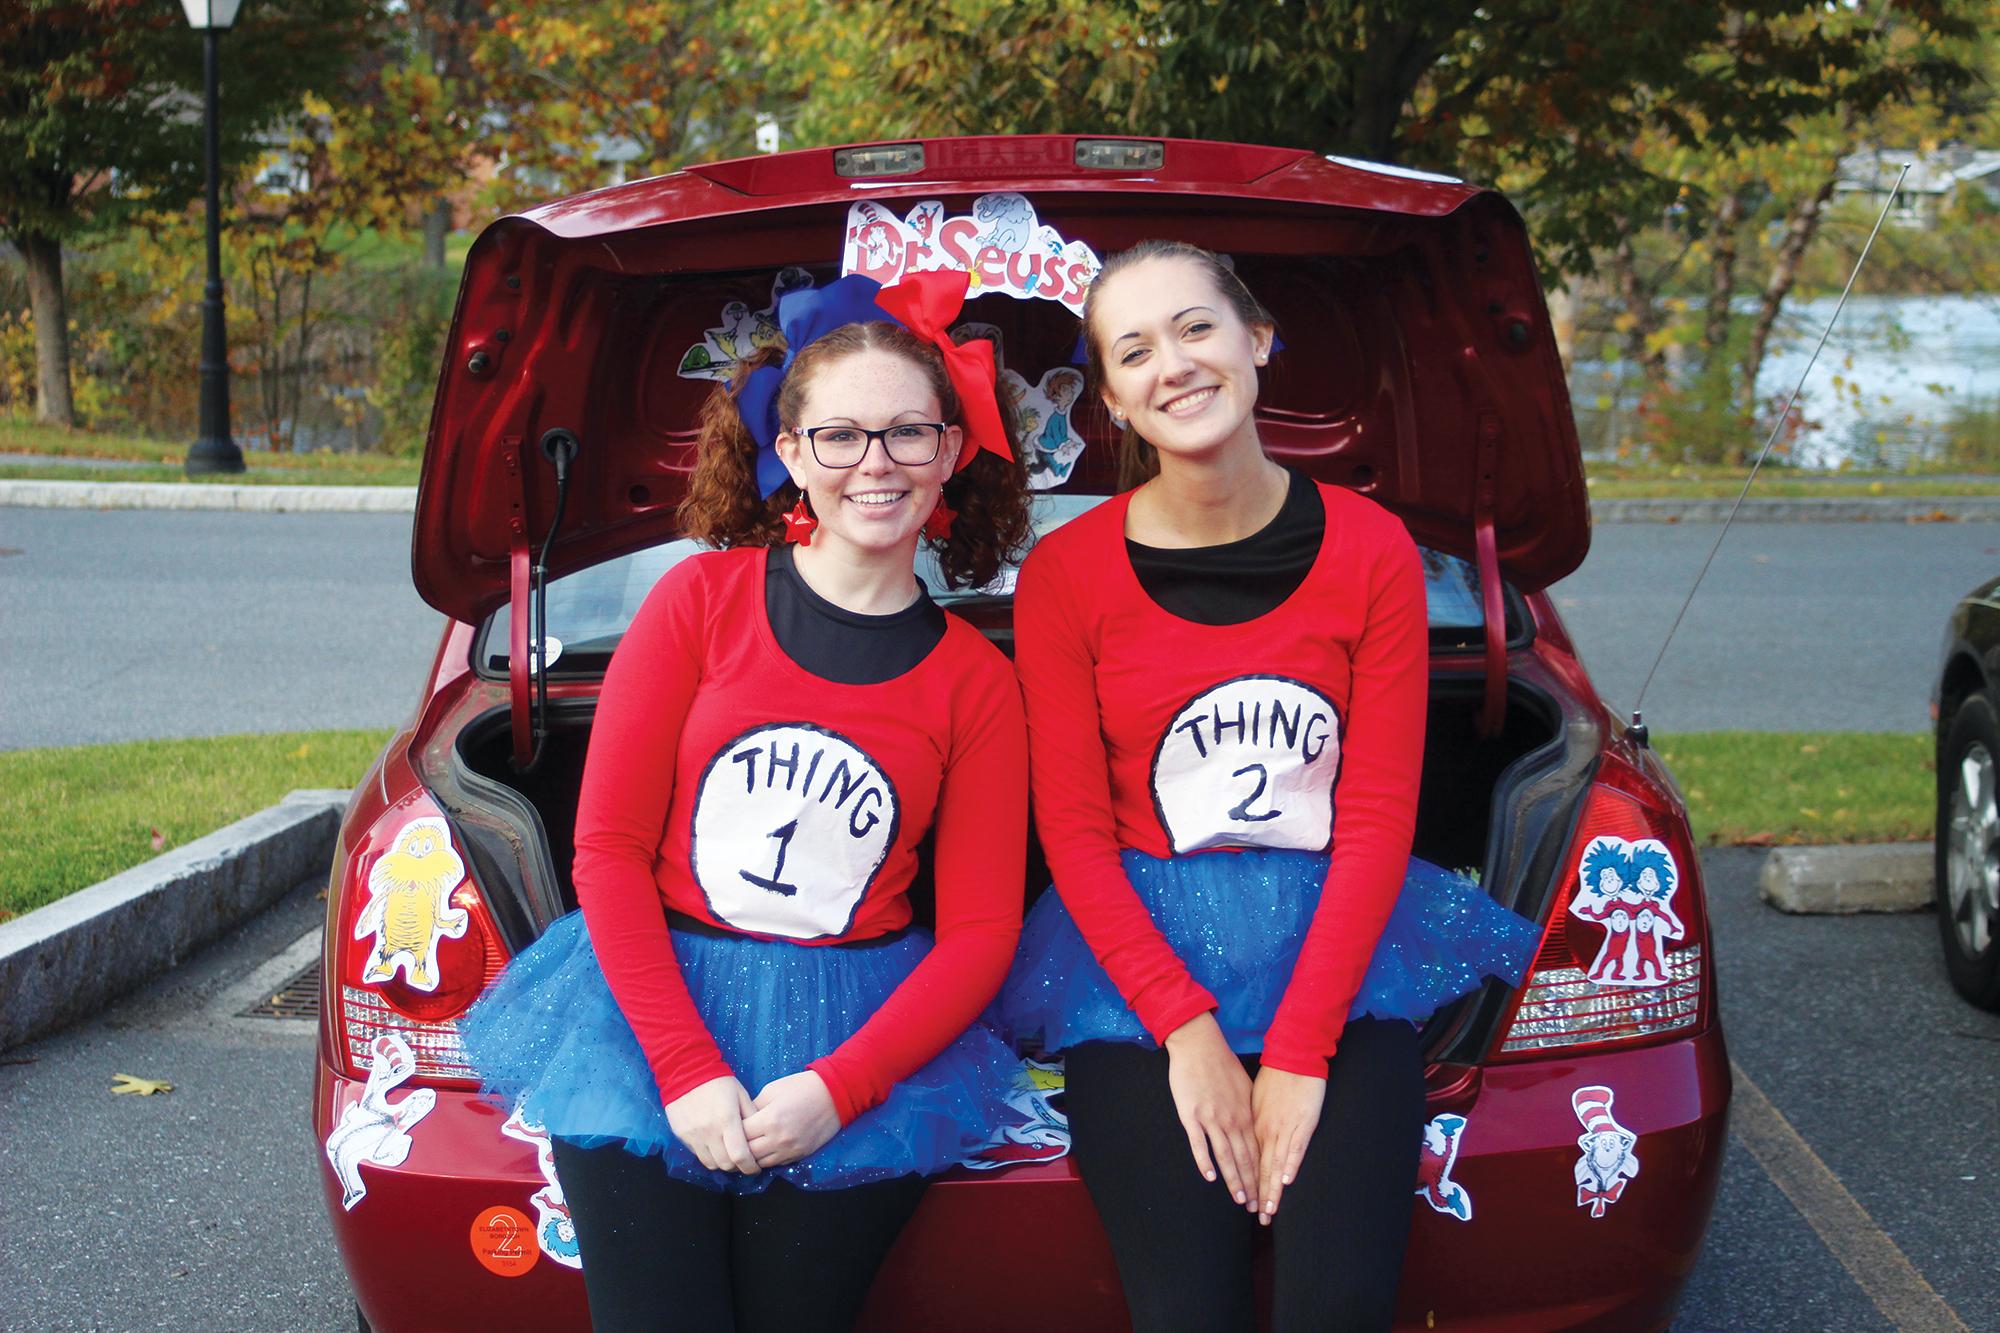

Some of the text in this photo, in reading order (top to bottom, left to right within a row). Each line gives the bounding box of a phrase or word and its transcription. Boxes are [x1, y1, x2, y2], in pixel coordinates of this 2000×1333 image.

[939, 219, 1092, 306] Seuss
[1175, 699, 1330, 765] THING
[732, 740, 883, 839] THING
[1227, 763, 1282, 822] 2
[738, 818, 798, 897] 1
[482, 1248, 508, 1256] Parking
[489, 1214, 522, 1258] 2
